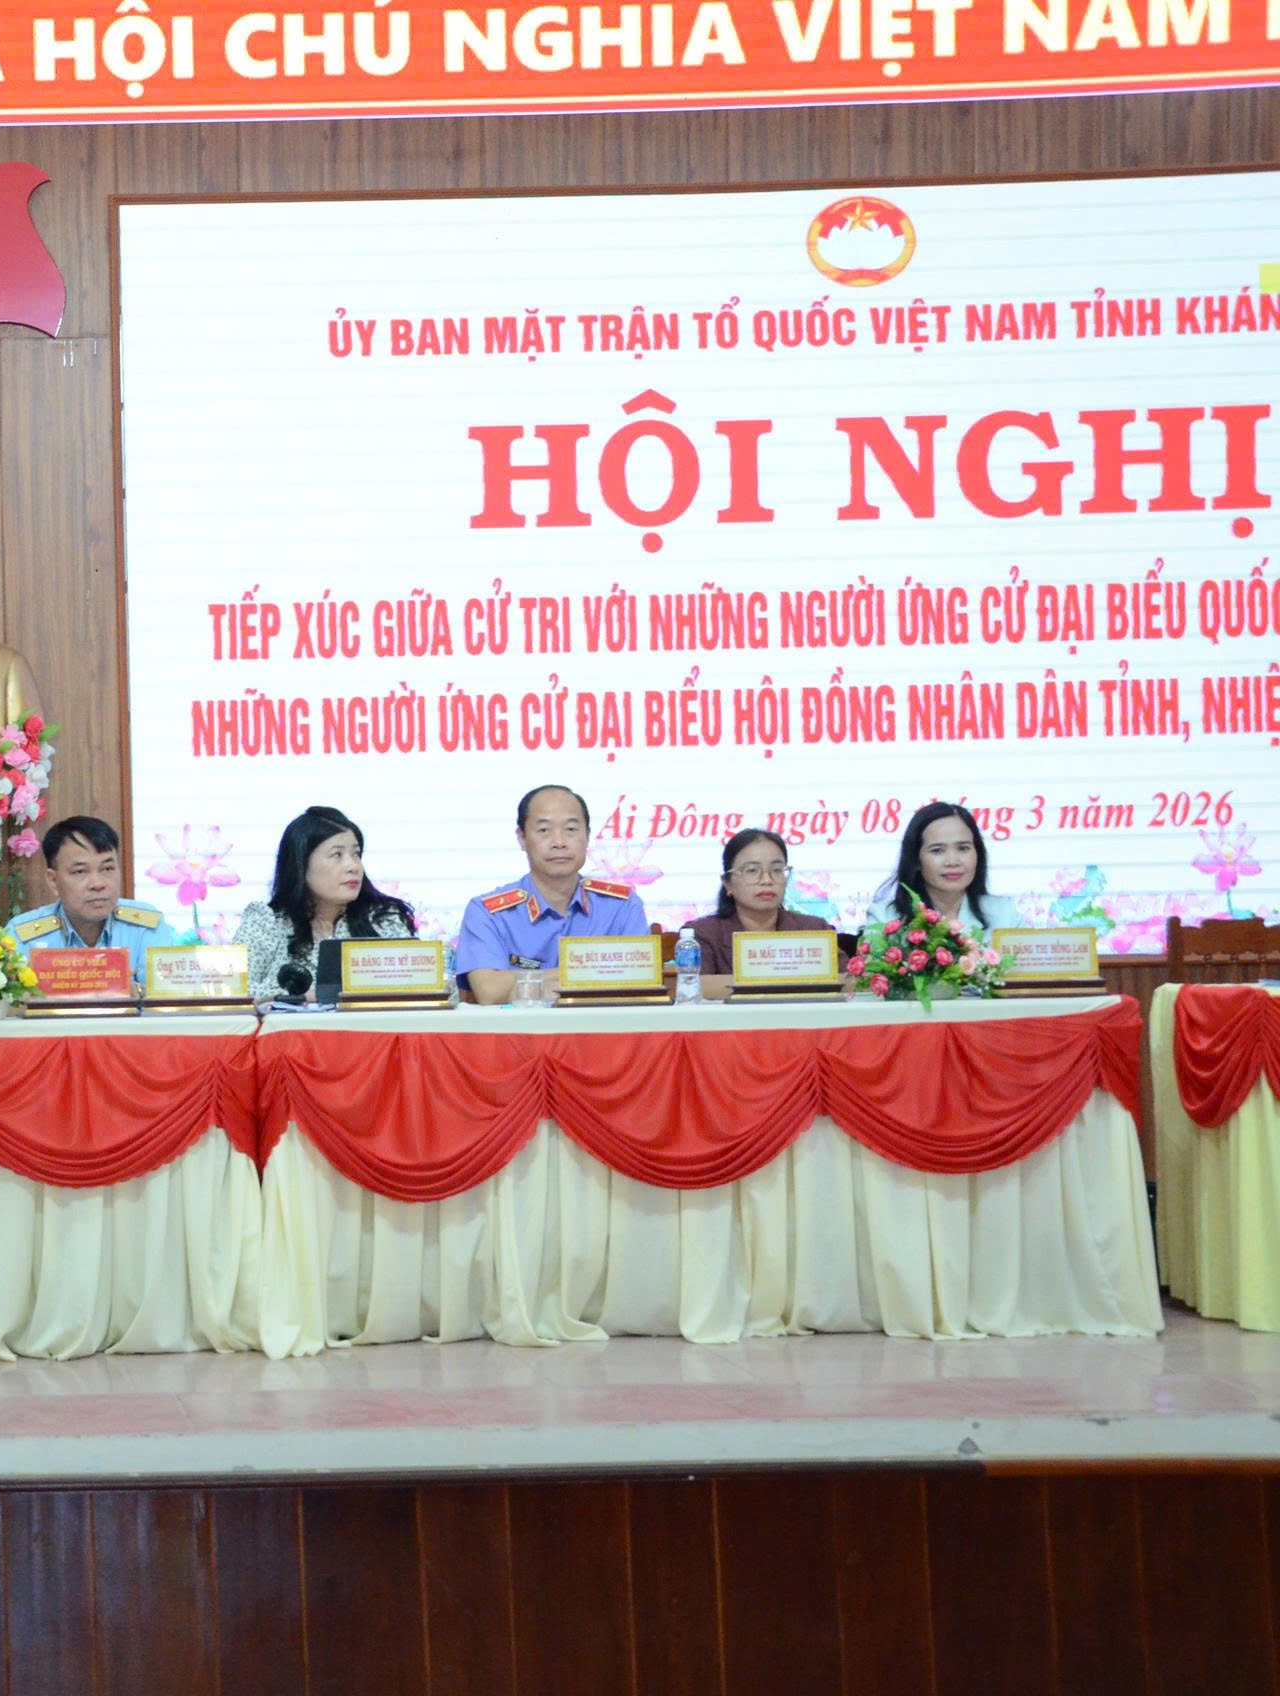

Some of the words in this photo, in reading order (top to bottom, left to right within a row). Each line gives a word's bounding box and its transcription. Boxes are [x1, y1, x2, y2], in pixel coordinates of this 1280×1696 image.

[34, 0, 193, 98] HỘI
[1004, 0, 1229, 53] NAM
[329, 308, 375, 357] ỦY
[391, 318, 469, 356] BAN
[484, 308, 565, 362] MẶT
[578, 306, 679, 359] TRẬN
[693, 297, 739, 349] TỔ
[754, 296, 856, 352] QUỐC
[870, 298, 951, 352] VIỆT
[966, 302, 1056, 342] NAM
[1072, 288, 1161, 338] TỈNH
[468, 390, 774, 552] HỘI
[836, 404, 1272, 538] NGHỊ
[209, 585, 280, 660] TIẾP
[294, 591, 360, 658] XÚC
[373, 589, 452, 657] GIỮA
[464, 578, 511, 655] CỬ
[520, 597, 571, 653] TRI
[583, 583, 637, 652] VỚI
[650, 583, 768, 651] NHỮNG
[780, 576, 885, 648] NGƯỜI
[898, 576, 968, 645] ỨNG
[980, 566, 1029, 644] CỬ
[1037, 584, 1094, 654] ĐẠI
[1107, 559, 1186, 640] BIỂU
[192, 689, 310, 756] NHỮNG
[322, 682, 426, 753] NGƯỜI
[439, 684, 508, 752] ỨNG
[521, 673, 568, 750] CỬ
[576, 692, 632, 762] ĐẠI
[645, 666, 722, 747] BIỂU
[734, 676, 790, 758] HỘI
[801, 668, 896, 744] ĐỒNG
[908, 671, 1004, 741] NHÂN
[1017, 669, 1088, 738] DÂN
[1099, 660, 1190, 743] TỈNH,
[596, 795, 637, 839] Ái
[766, 800, 849, 845] ngày
[861, 799, 902, 833] 08
[1026, 795, 1045, 830] 3
[1058, 795, 1135, 829] năm
[1148, 790, 1234, 828] 2026
